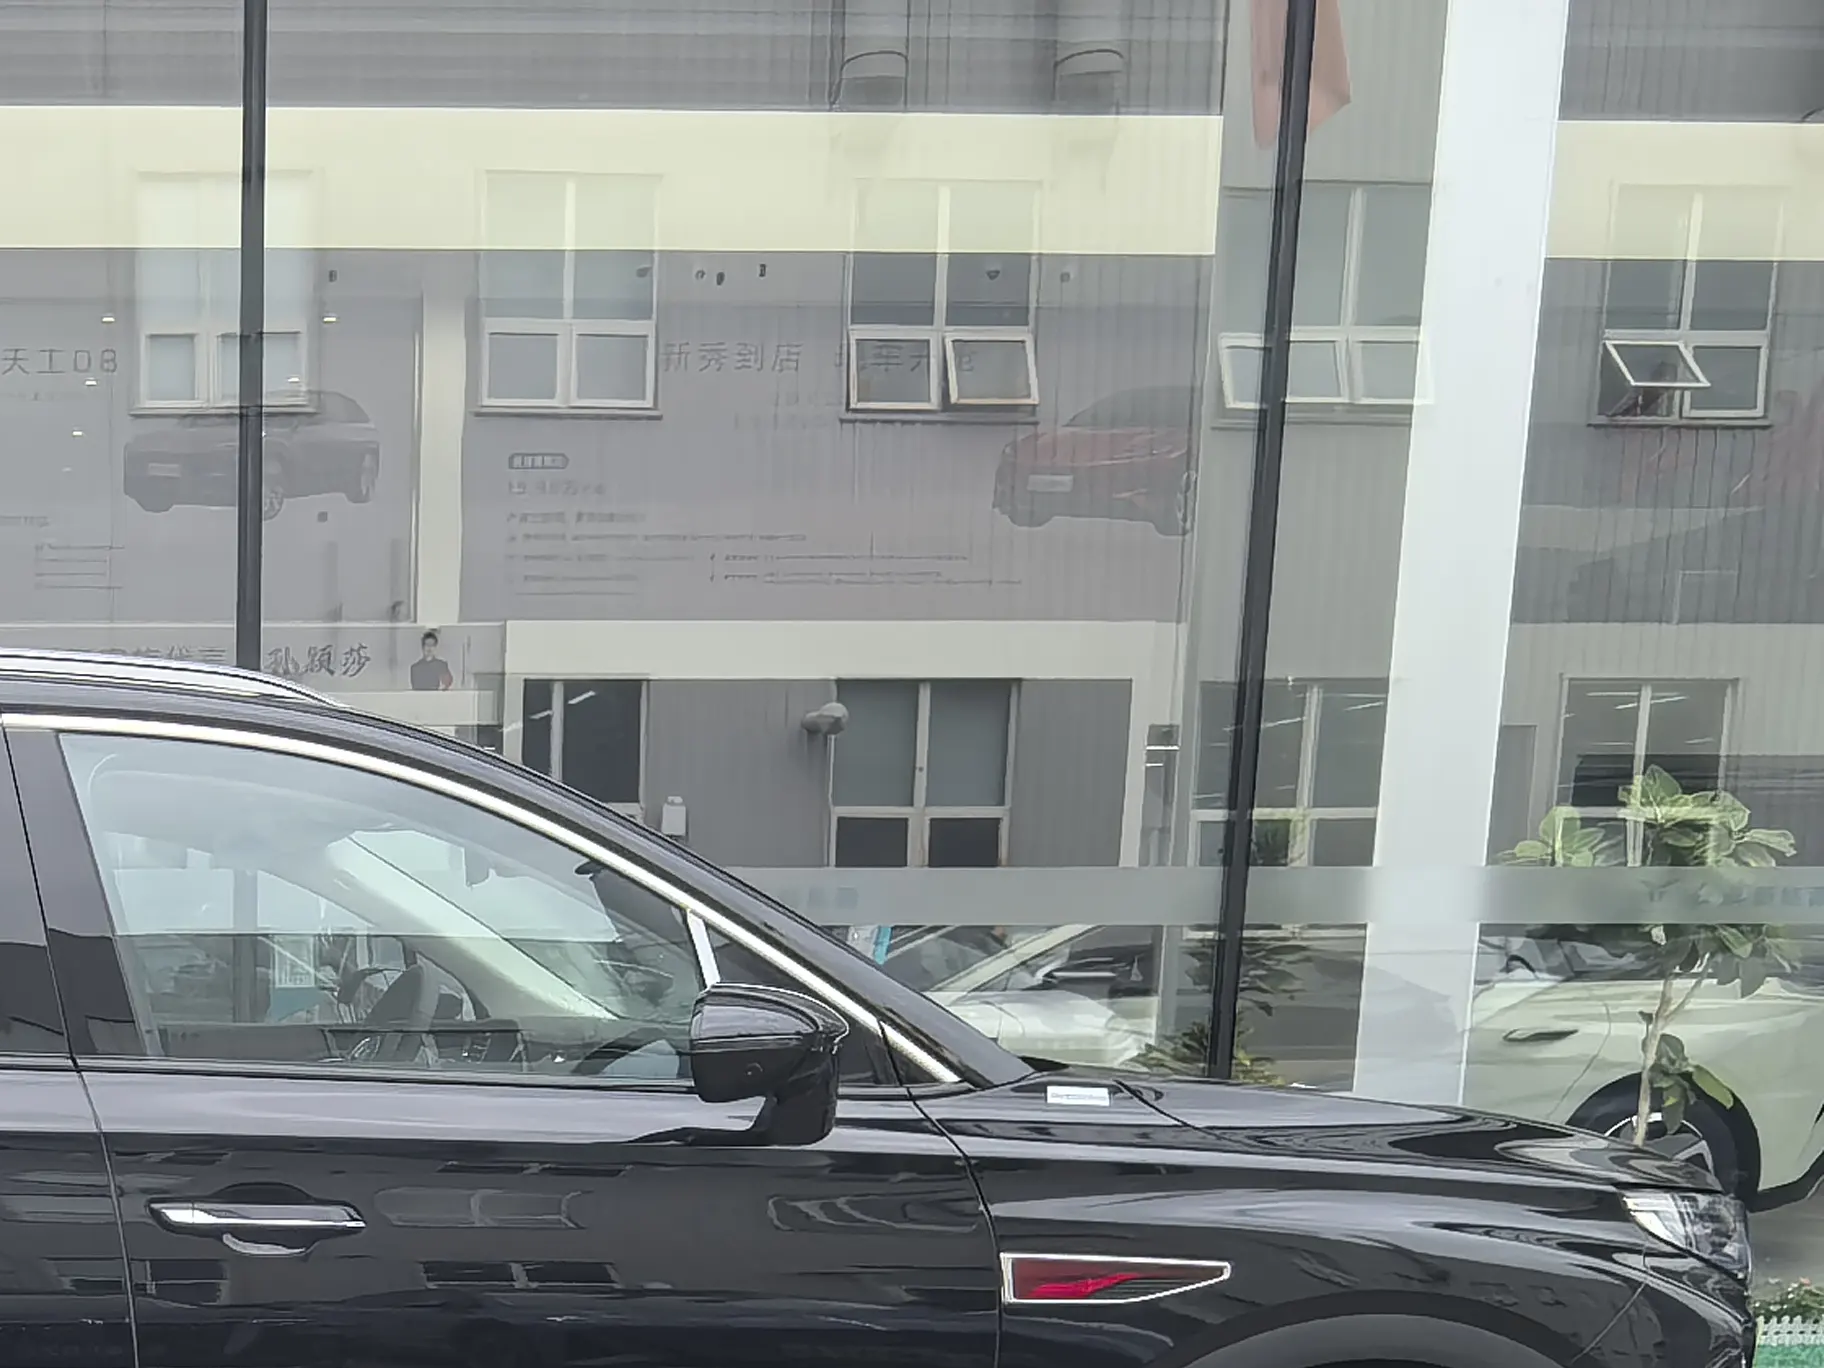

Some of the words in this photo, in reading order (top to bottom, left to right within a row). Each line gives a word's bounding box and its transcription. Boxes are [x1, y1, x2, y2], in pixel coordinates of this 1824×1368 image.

[0, 347, 118, 375] 天工08
[661, 341, 804, 373] 新秀到店
